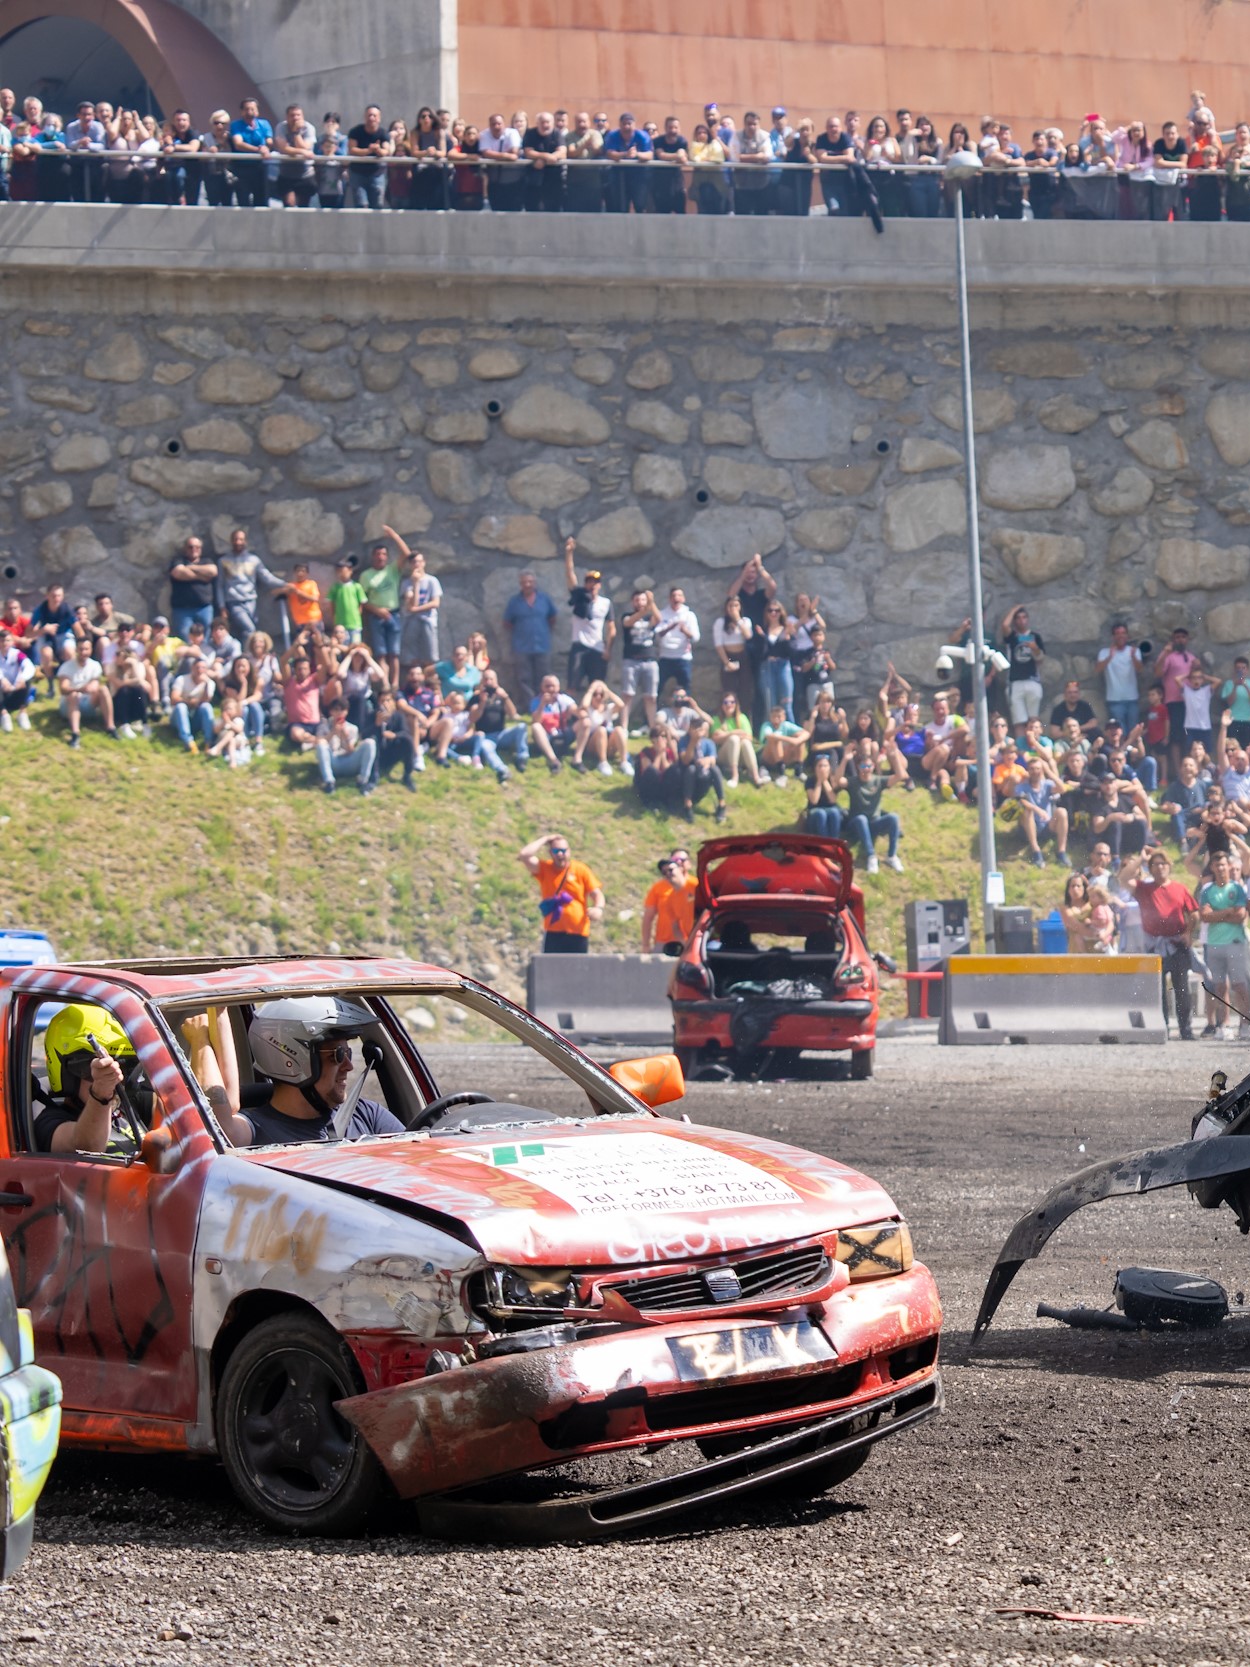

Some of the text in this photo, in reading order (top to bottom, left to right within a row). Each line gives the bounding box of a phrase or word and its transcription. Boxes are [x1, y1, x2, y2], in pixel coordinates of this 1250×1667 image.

[577, 1192, 615, 1204] Tel
[633, 1186, 686, 1198] +376
[688, 1183, 717, 1195] 34
[718, 1181, 748, 1192] 73
[749, 1180, 777, 1191] 81
